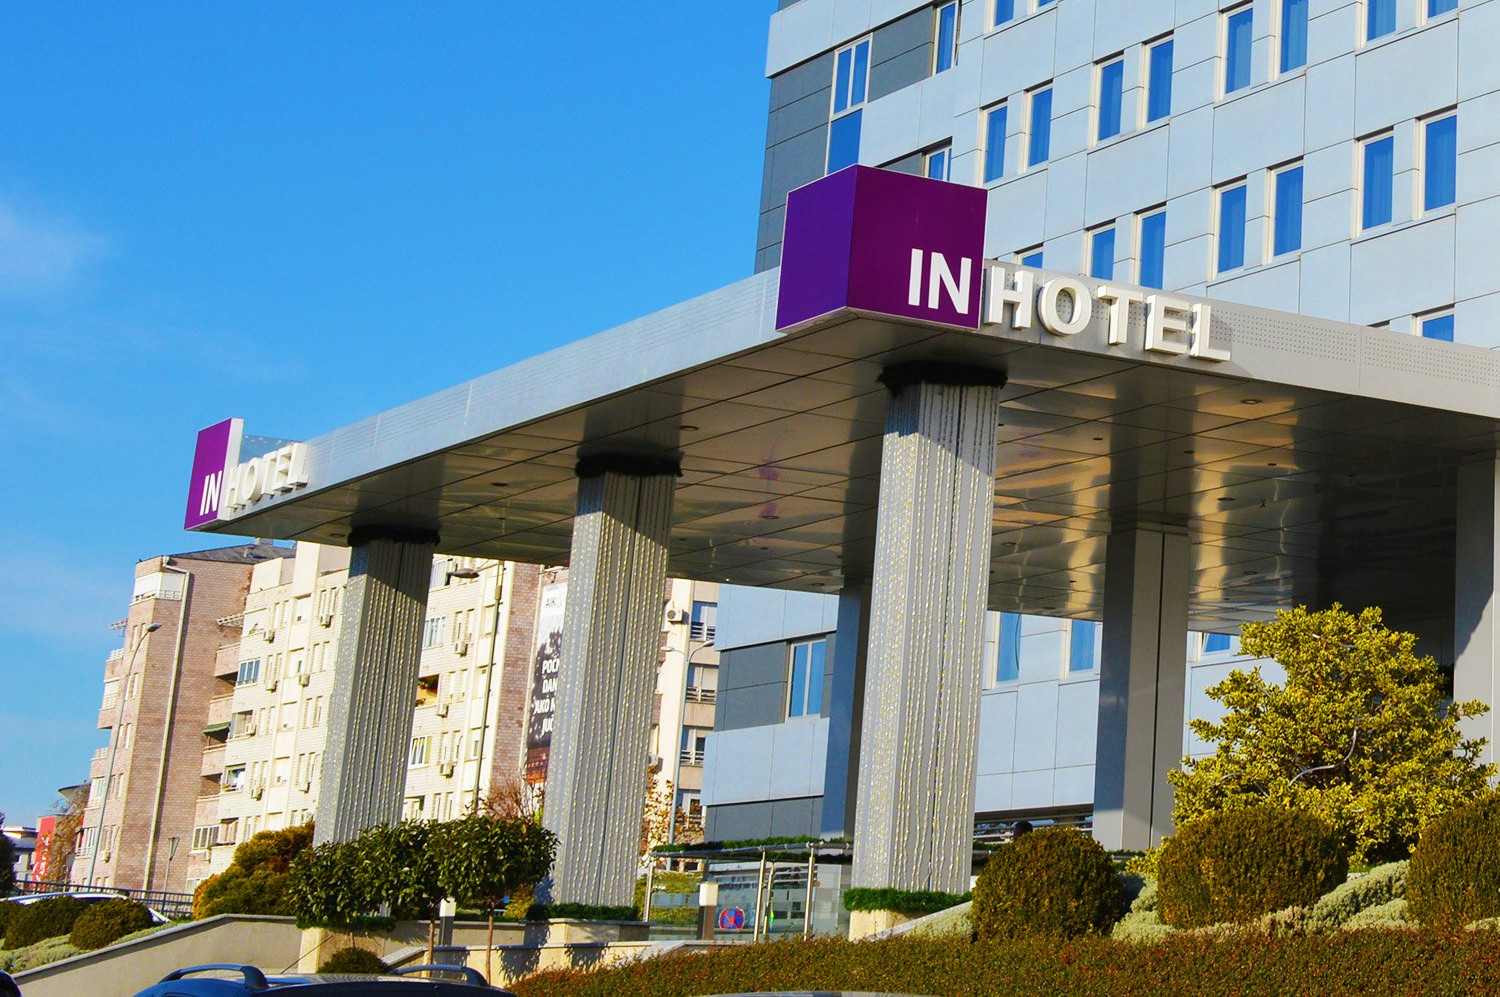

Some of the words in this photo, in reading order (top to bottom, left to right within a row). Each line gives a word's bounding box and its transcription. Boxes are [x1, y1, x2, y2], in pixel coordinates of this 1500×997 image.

[908, 248, 972, 315] IN
[983, 265, 1231, 362] HOTEL
[200, 470, 222, 516] IN
[226, 442, 309, 510] HOTEL
